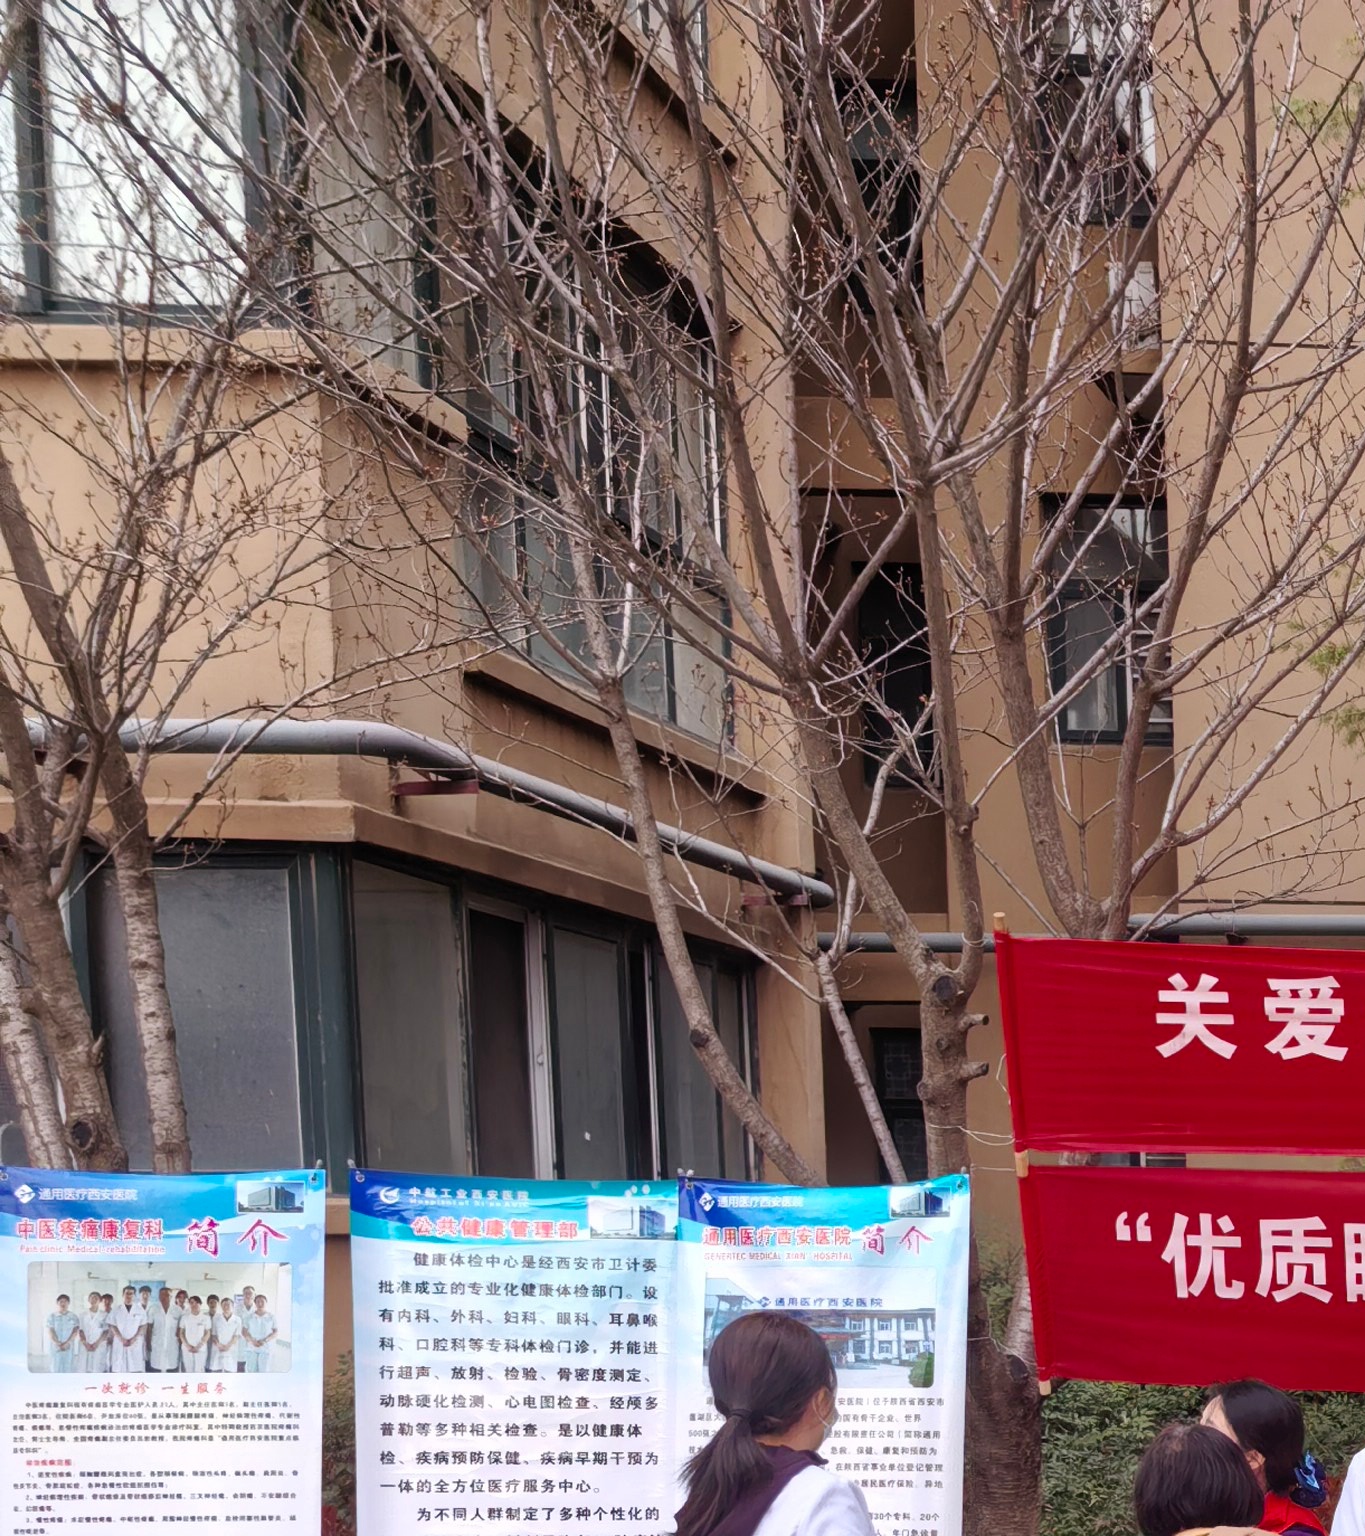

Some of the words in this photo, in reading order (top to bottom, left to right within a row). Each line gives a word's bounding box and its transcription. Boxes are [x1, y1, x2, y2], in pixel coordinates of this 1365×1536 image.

[39, 1188, 139, 1201] 通用医疗西安医院
[717, 1195, 804, 1208] 通用医疗西安医院
[413, 1215, 578, 1239] 公共健康管理部
[17, 1219, 164, 1241] 中医疼痛康复科
[186, 1217, 289, 1257] 简介
[702, 1227, 852, 1247] 通用医疗西安医院
[862, 1225, 934, 1255] 简介
[413, 1252, 658, 1273] 健康体检中心是经西安市卫计委
[775, 1296, 883, 1308] 通用医疗西安医院
[416, 1507, 661, 1523] 为不同人群制定了多种个性化的
